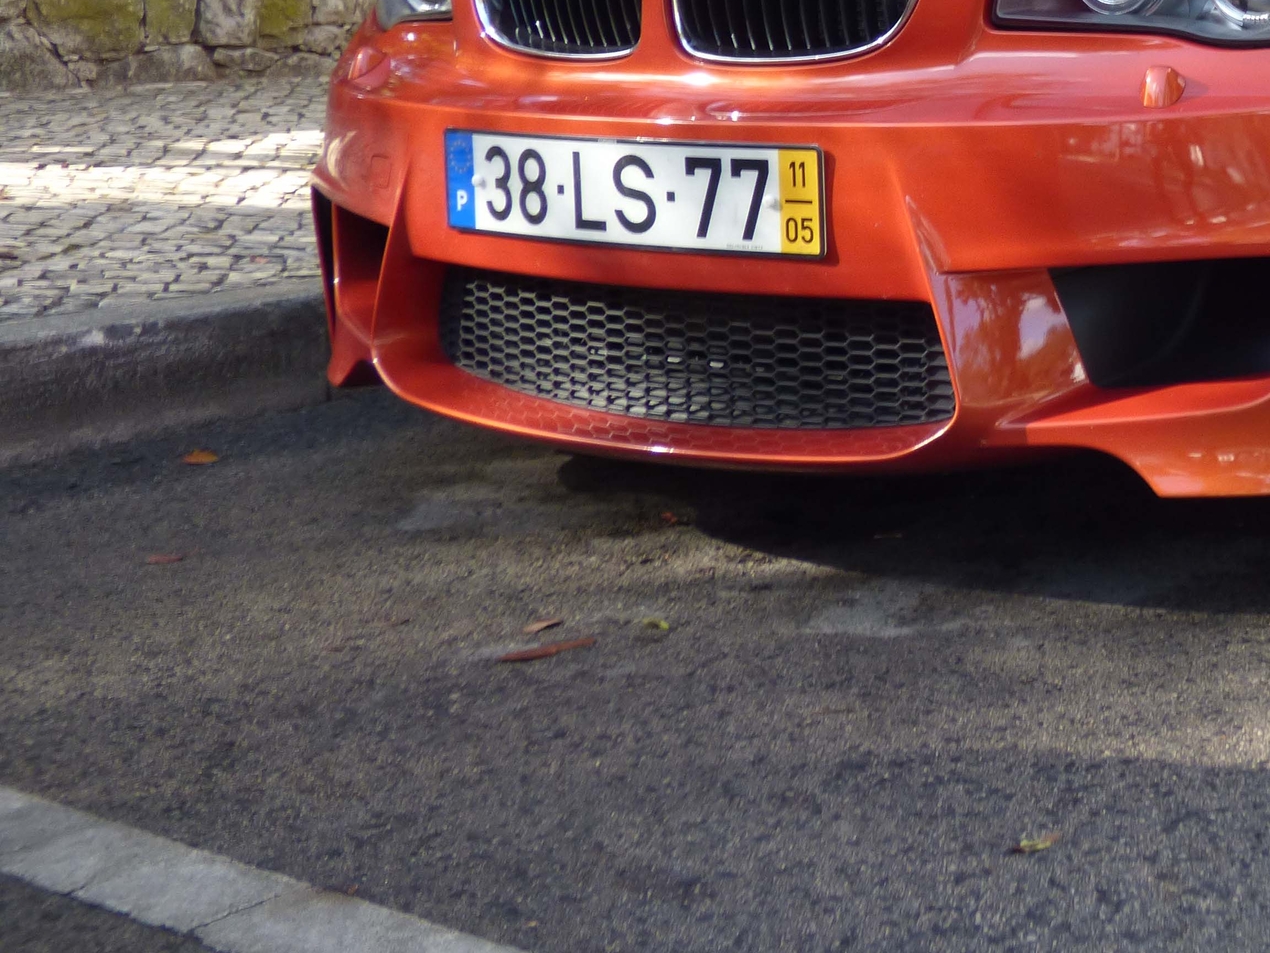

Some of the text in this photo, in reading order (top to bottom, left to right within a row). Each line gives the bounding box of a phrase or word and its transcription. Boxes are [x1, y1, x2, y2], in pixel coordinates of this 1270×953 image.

[788, 161, 806, 188] 11
[456, 189, 468, 212] P
[785, 217, 814, 244] 05
